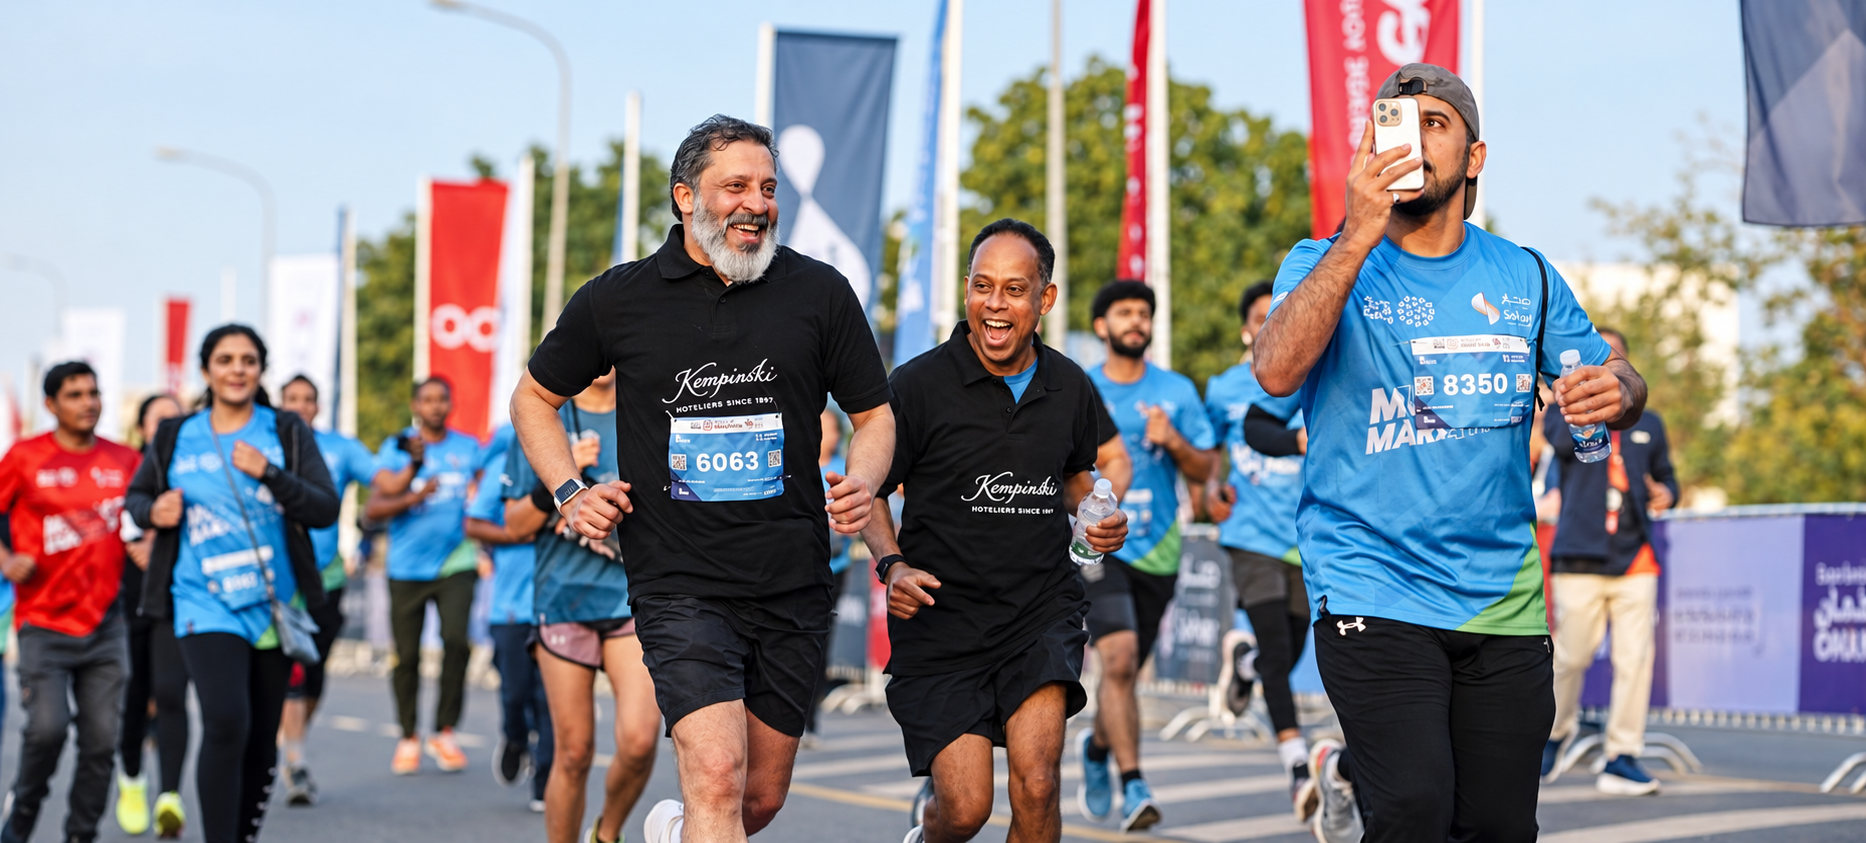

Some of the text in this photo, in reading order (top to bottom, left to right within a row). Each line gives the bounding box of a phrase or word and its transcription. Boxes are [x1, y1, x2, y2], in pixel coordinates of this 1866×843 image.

[661, 358, 777, 403] Kempinski
[1443, 373, 1508, 395] 8350
[676, 400, 723, 413] HOTELIERS
[726, 398, 752, 407] SINCE
[696, 451, 759, 472] 6063
[960, 471, 1057, 504] Kempinski
[971, 506, 1016, 514] HOTELIERS
[1018, 507, 1041, 515] SINCE
